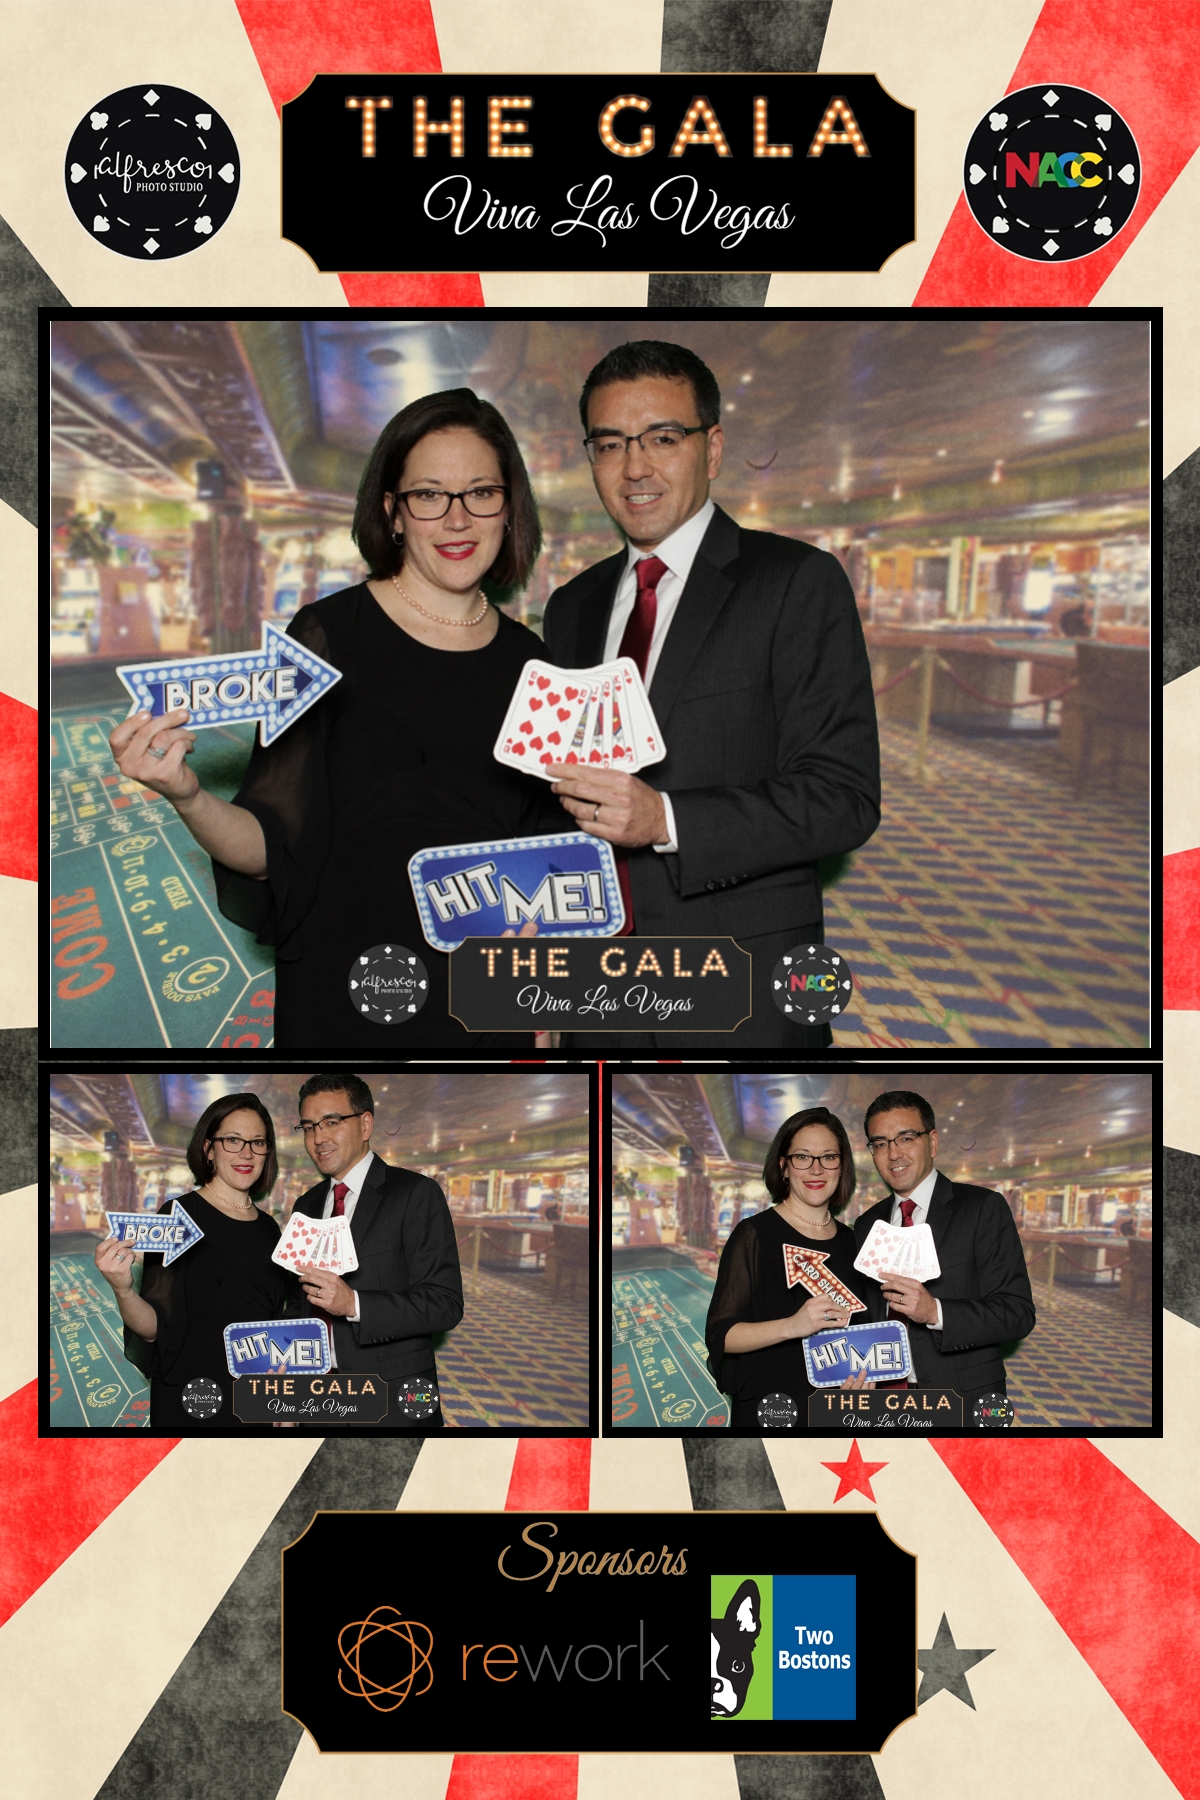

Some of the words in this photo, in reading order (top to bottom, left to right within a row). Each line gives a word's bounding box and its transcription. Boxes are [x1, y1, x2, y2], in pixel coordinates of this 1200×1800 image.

[163, 666, 297, 712] BROKE
[161, 875, 193, 911] FIELD
[426, 862, 499, 922] HIT
[500, 871, 606, 924] ME!
[51, 887, 116, 1000] COME
[188, 963, 219, 984] 2
[125, 1224, 185, 1243] BROKE
[793, 1254, 821, 1281] CARD
[817, 1278, 851, 1309] SHARK
[231, 1331, 269, 1362] HIT
[270, 1339, 323, 1367] ME!
[810, 1337, 850, 1371] HIT
[850, 1342, 904, 1372] ME!
